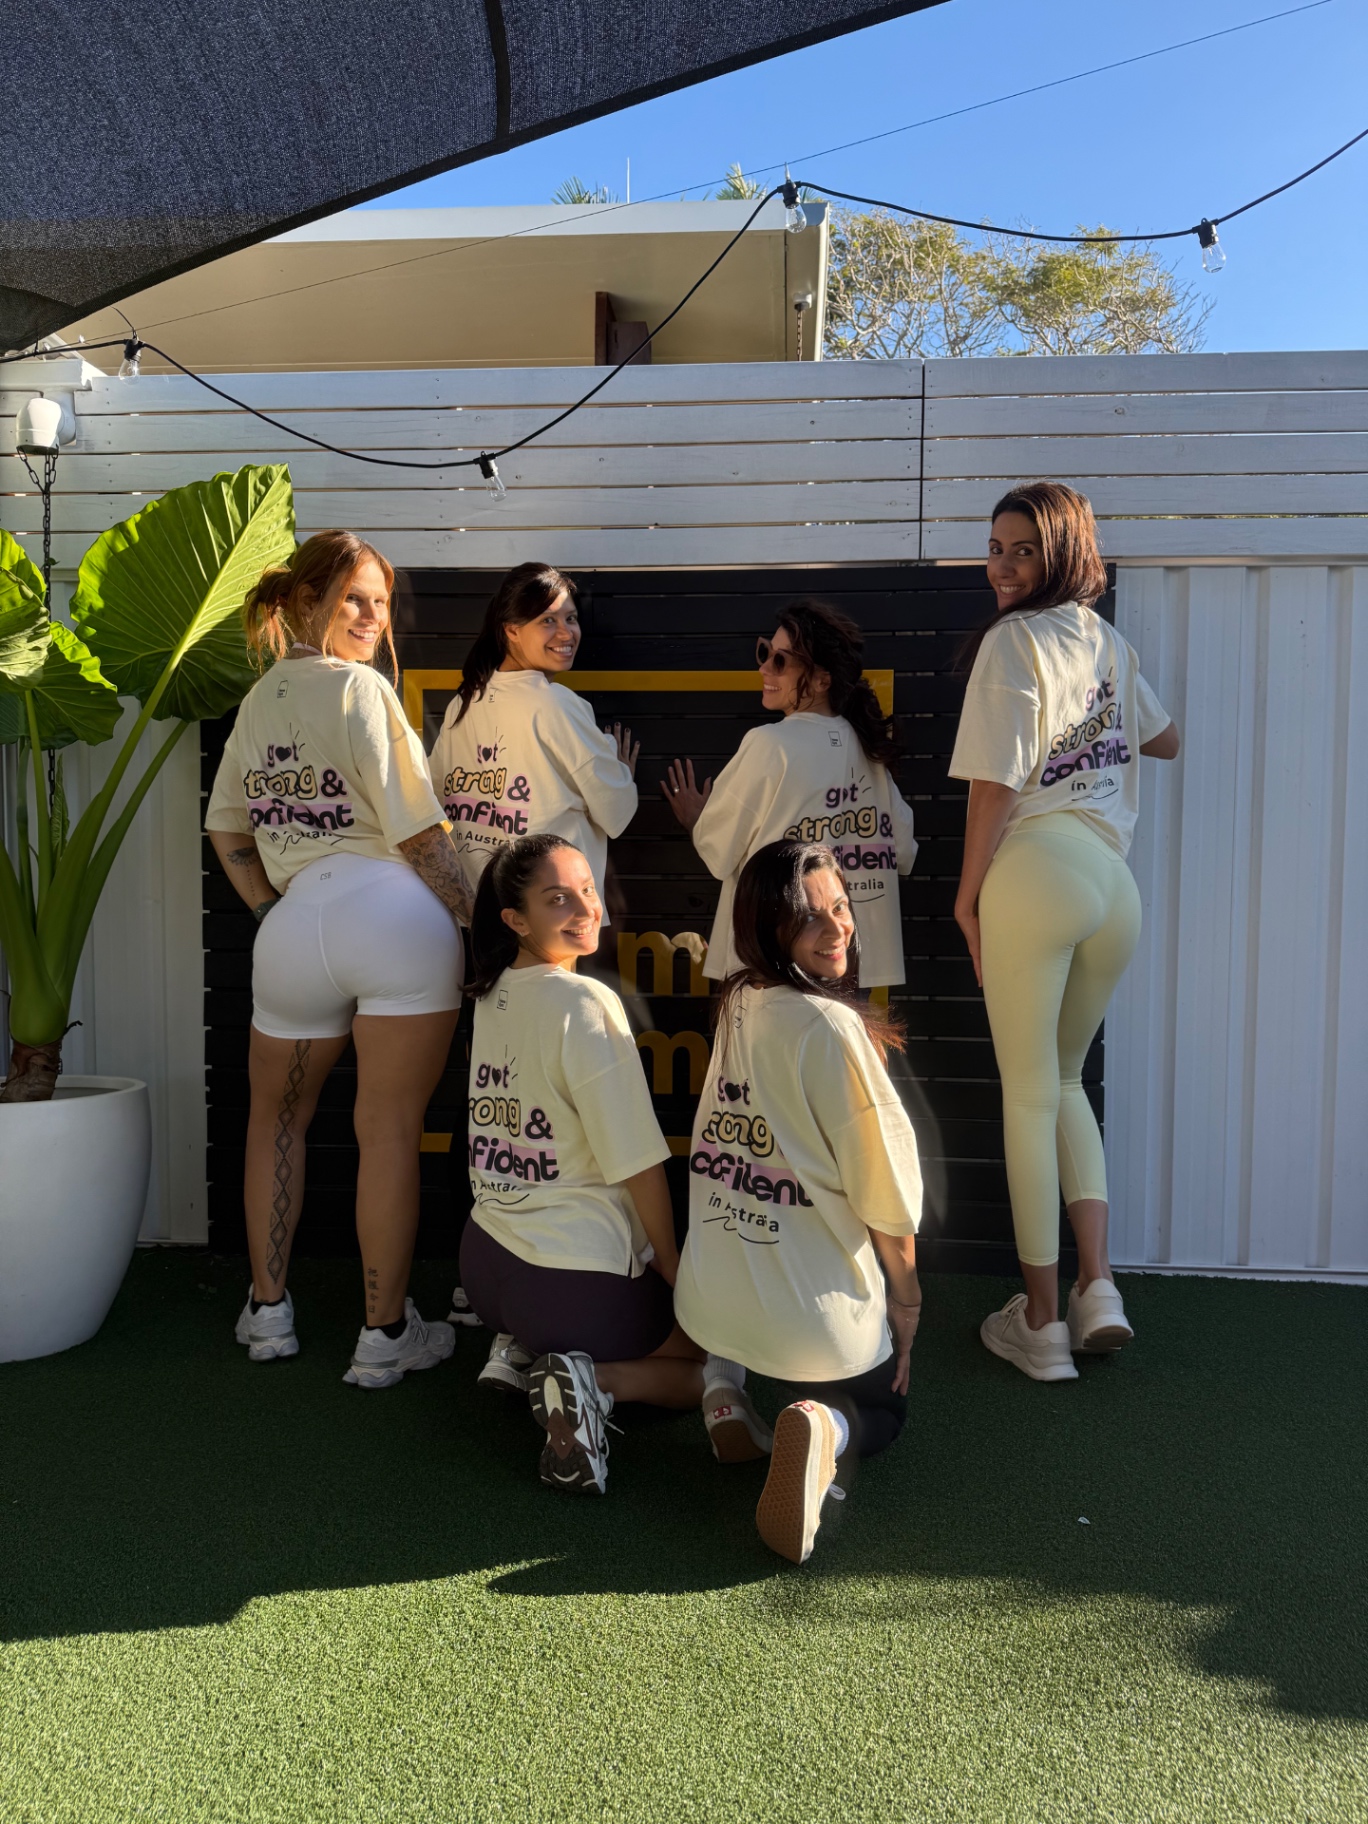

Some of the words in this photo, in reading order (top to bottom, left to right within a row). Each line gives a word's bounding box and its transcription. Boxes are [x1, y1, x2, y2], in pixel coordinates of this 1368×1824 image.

[320, 768, 347, 797] &
[507, 776, 530, 802] &
[1071, 779, 1086, 791] in
[880, 813, 893, 838] &
[267, 831, 280, 843] in
[456, 829, 463, 841] in
[848, 878, 885, 891] tralia
[524, 1108, 553, 1140] &
[708, 1192, 722, 1208] in
